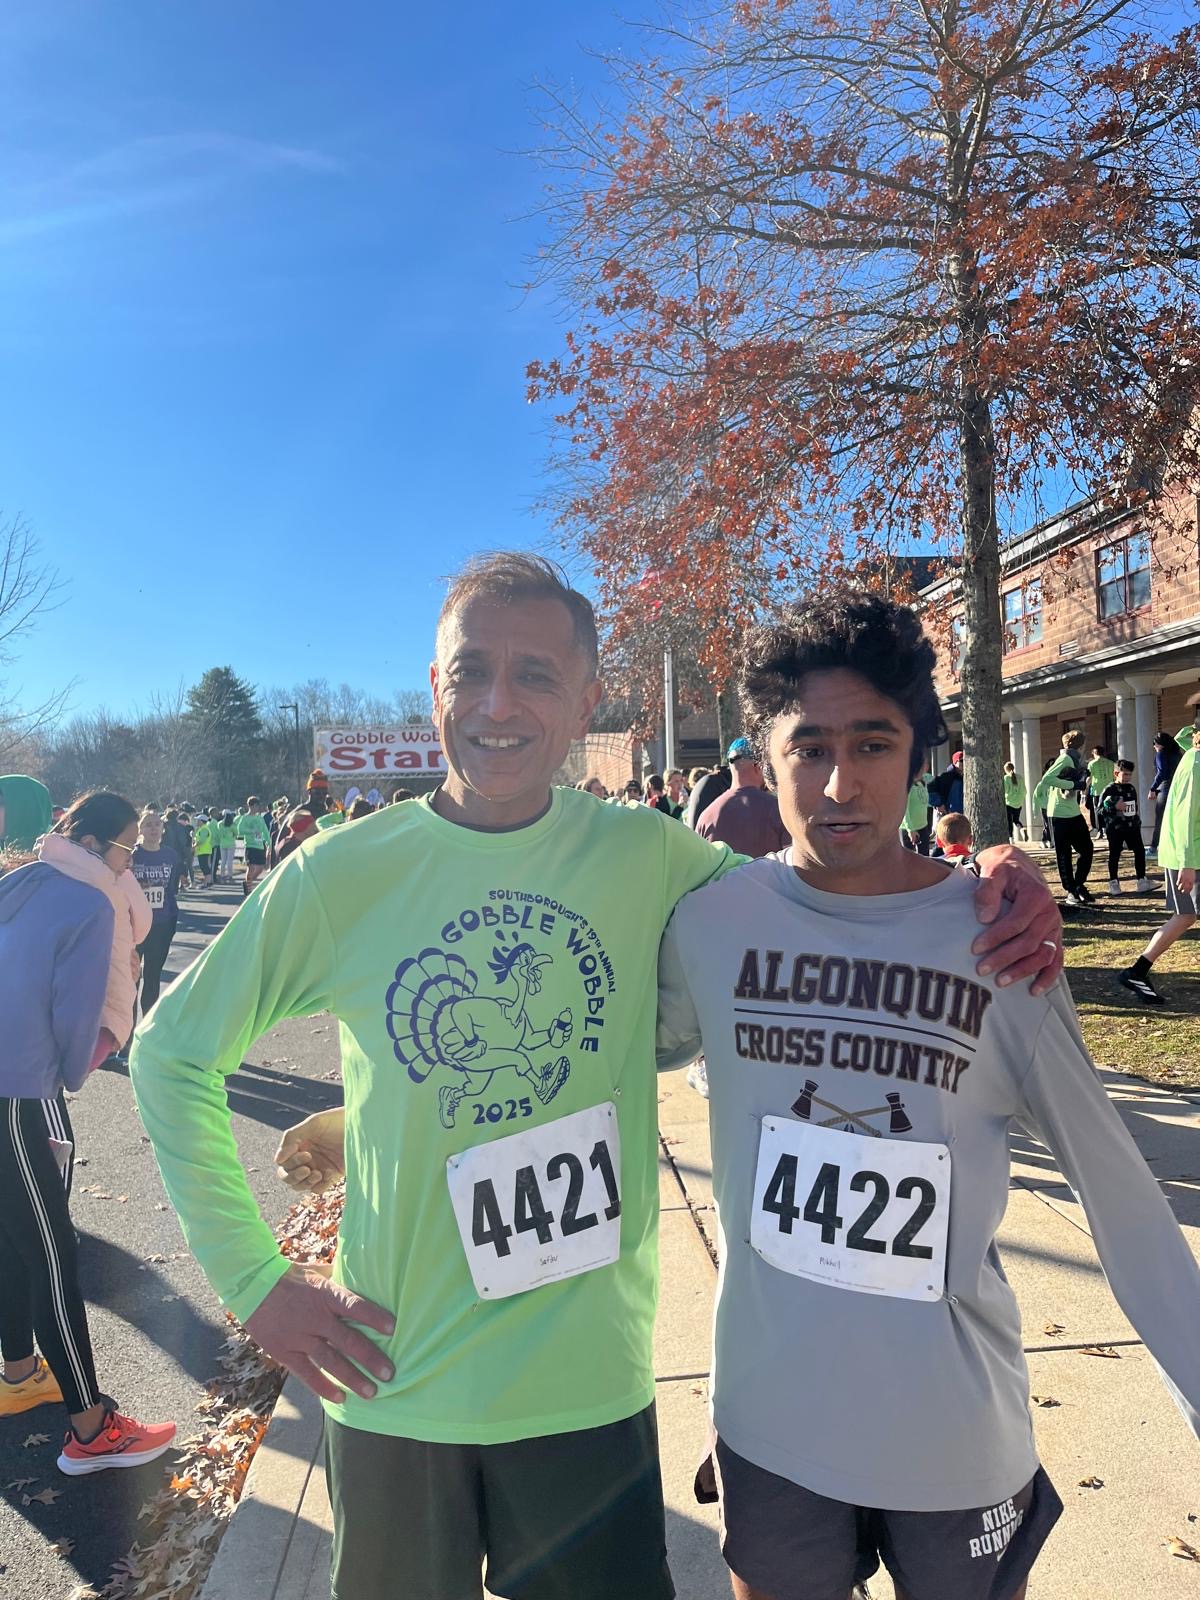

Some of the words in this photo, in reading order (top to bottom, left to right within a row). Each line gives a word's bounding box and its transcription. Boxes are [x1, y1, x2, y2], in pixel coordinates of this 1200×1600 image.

[330, 731, 396, 745] Gobble
[440, 904, 556, 944] GOBBLE
[565, 927, 605, 1053] WOBBLE
[488, 889, 589, 930] SOUTHBOROUGH'S
[597, 950, 616, 994] ANNUAL
[733, 948, 993, 1040] ALGONQUIN
[734, 1022, 827, 1068] CROSS
[830, 1031, 970, 1094] COUNTRY
[472, 1097, 533, 1125] 2025
[471, 1139, 621, 1258] 4421
[762, 1153, 937, 1260] 4422
[982, 1498, 1017, 1532] NIKE
